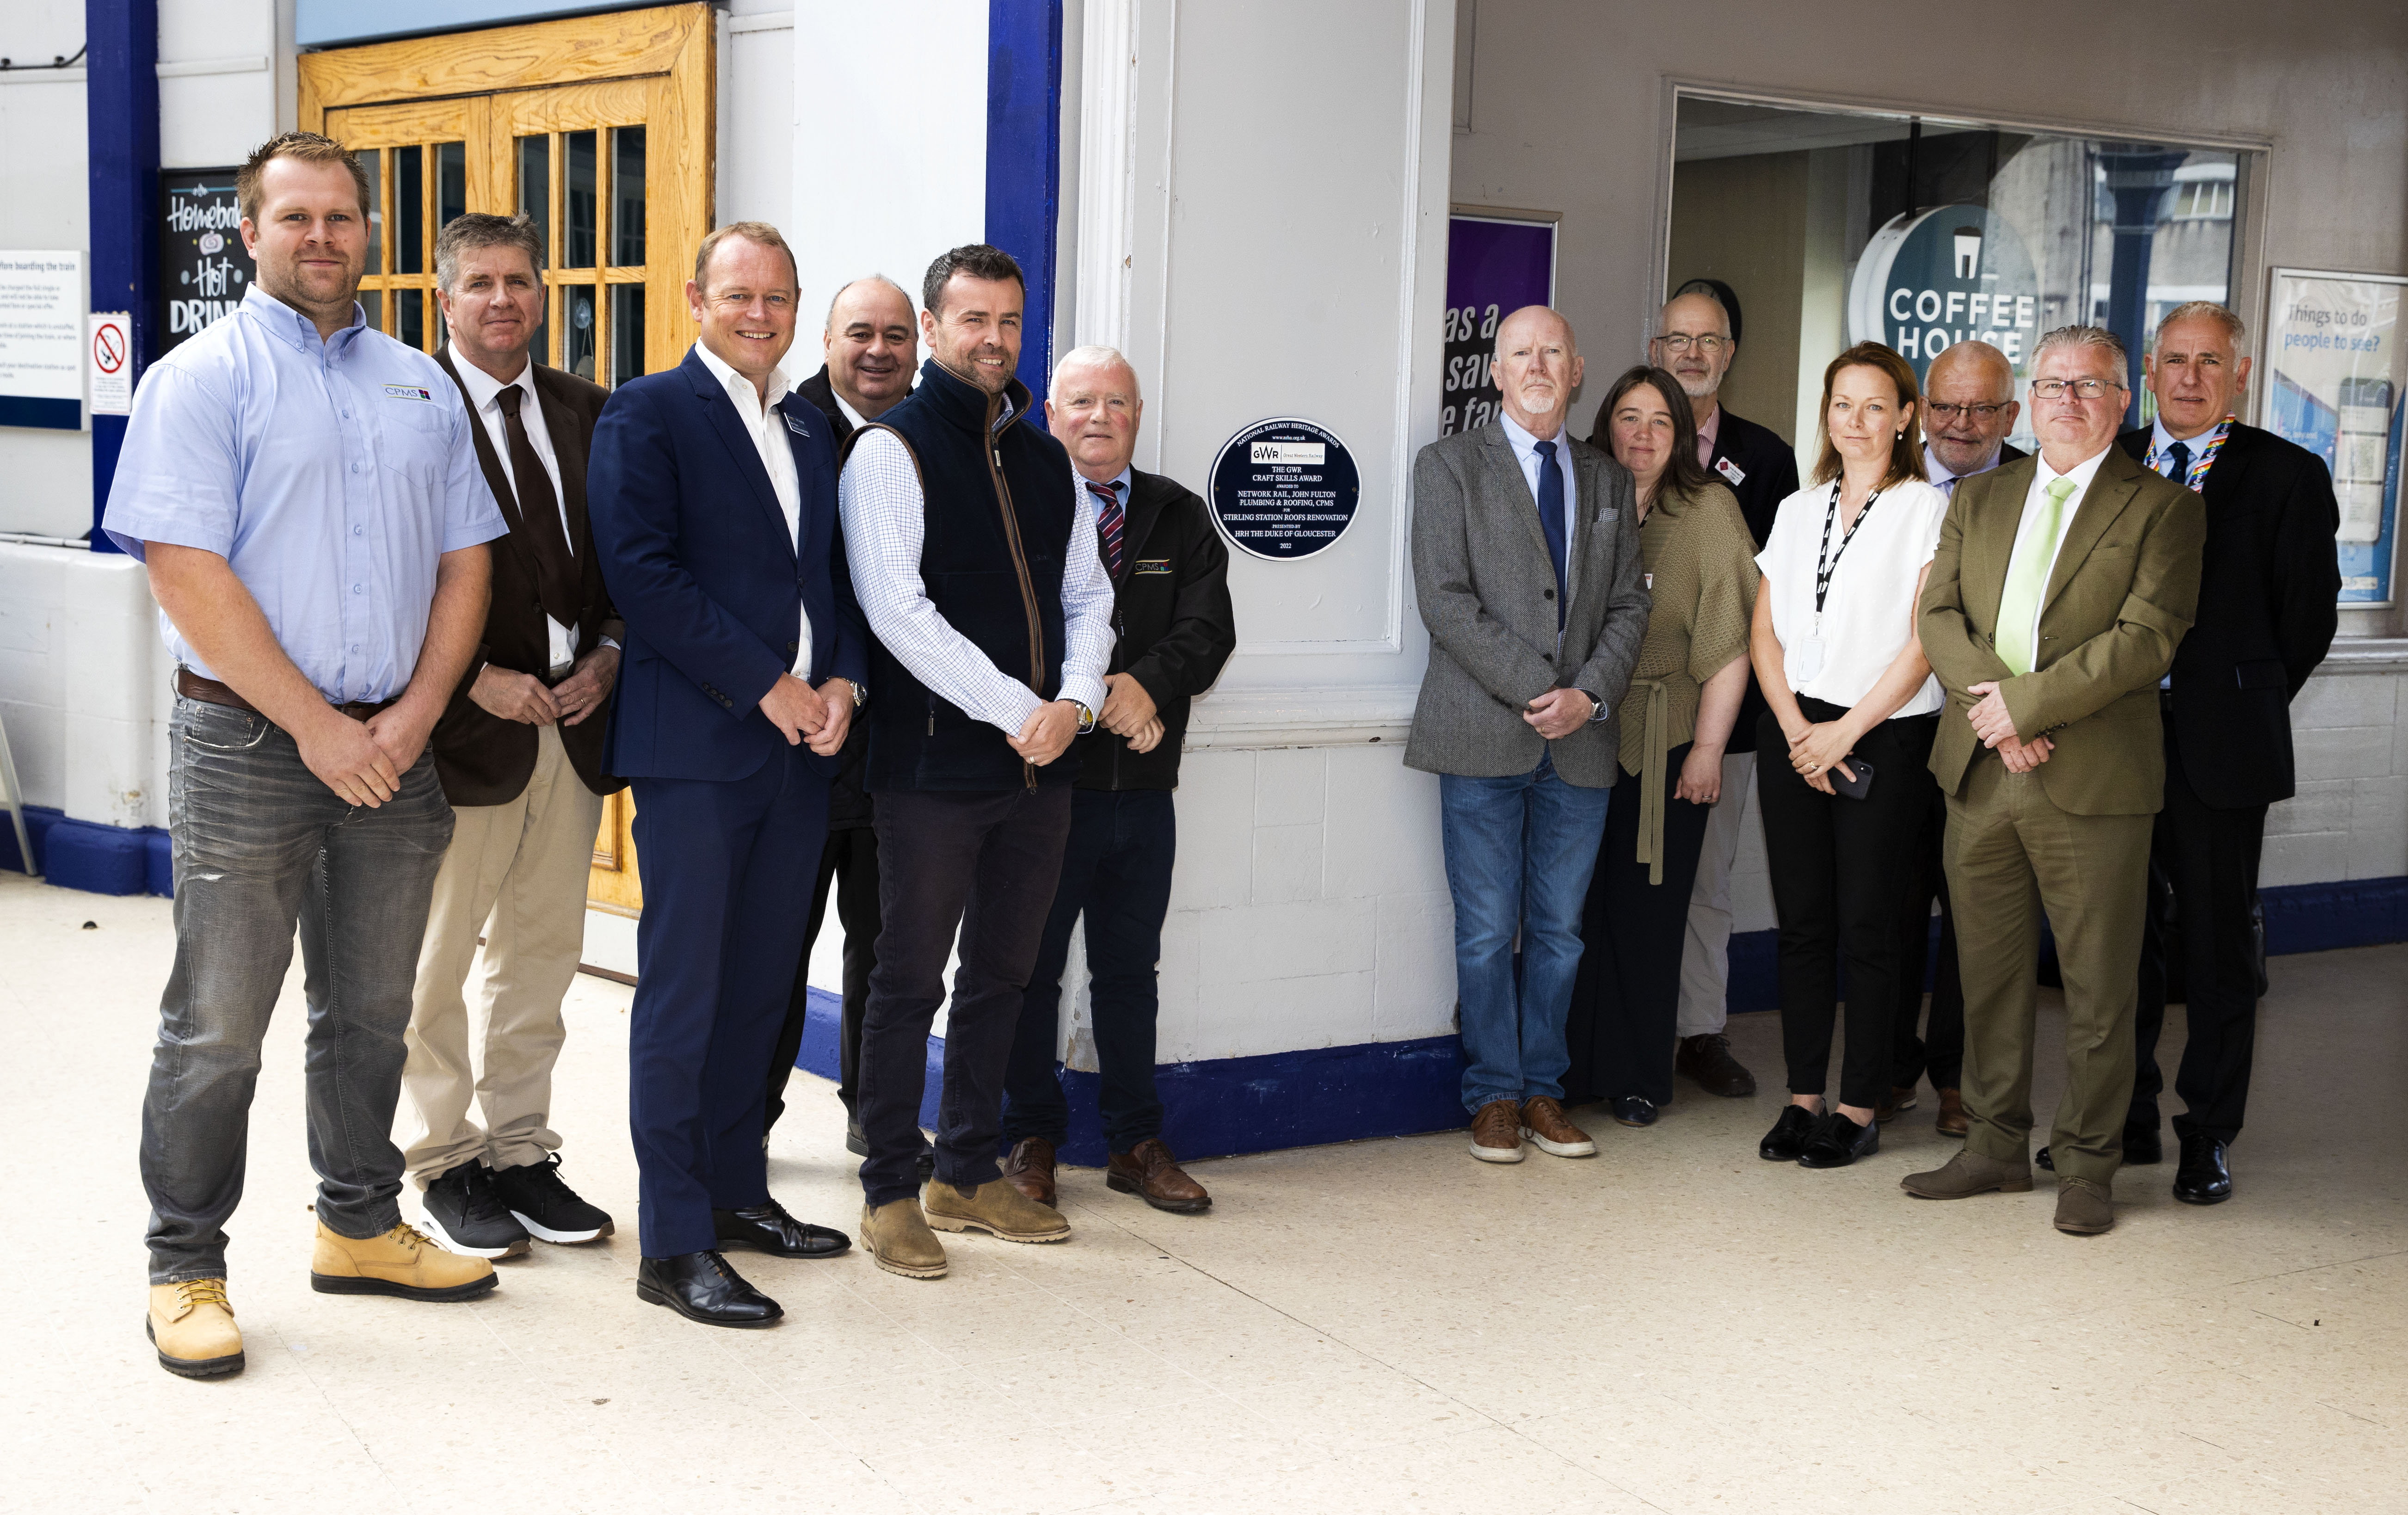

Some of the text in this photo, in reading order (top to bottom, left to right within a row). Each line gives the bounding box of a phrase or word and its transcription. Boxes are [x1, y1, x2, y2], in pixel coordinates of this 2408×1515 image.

[192, 257, 234, 297] Hot
[170, 299, 243, 333] DRIN
[1890, 288, 2034, 327] COFFEE
[2289, 304, 2367, 328] Things to do
[1480, 304, 1499, 339] a
[2285, 331, 2380, 352] people to see?
[385, 388, 418, 397] CPMS
[1237, 423, 1340, 448] NATIONAL RAILWAY HERITAGE AWARDS
[1253, 445, 1279, 461] GWR
